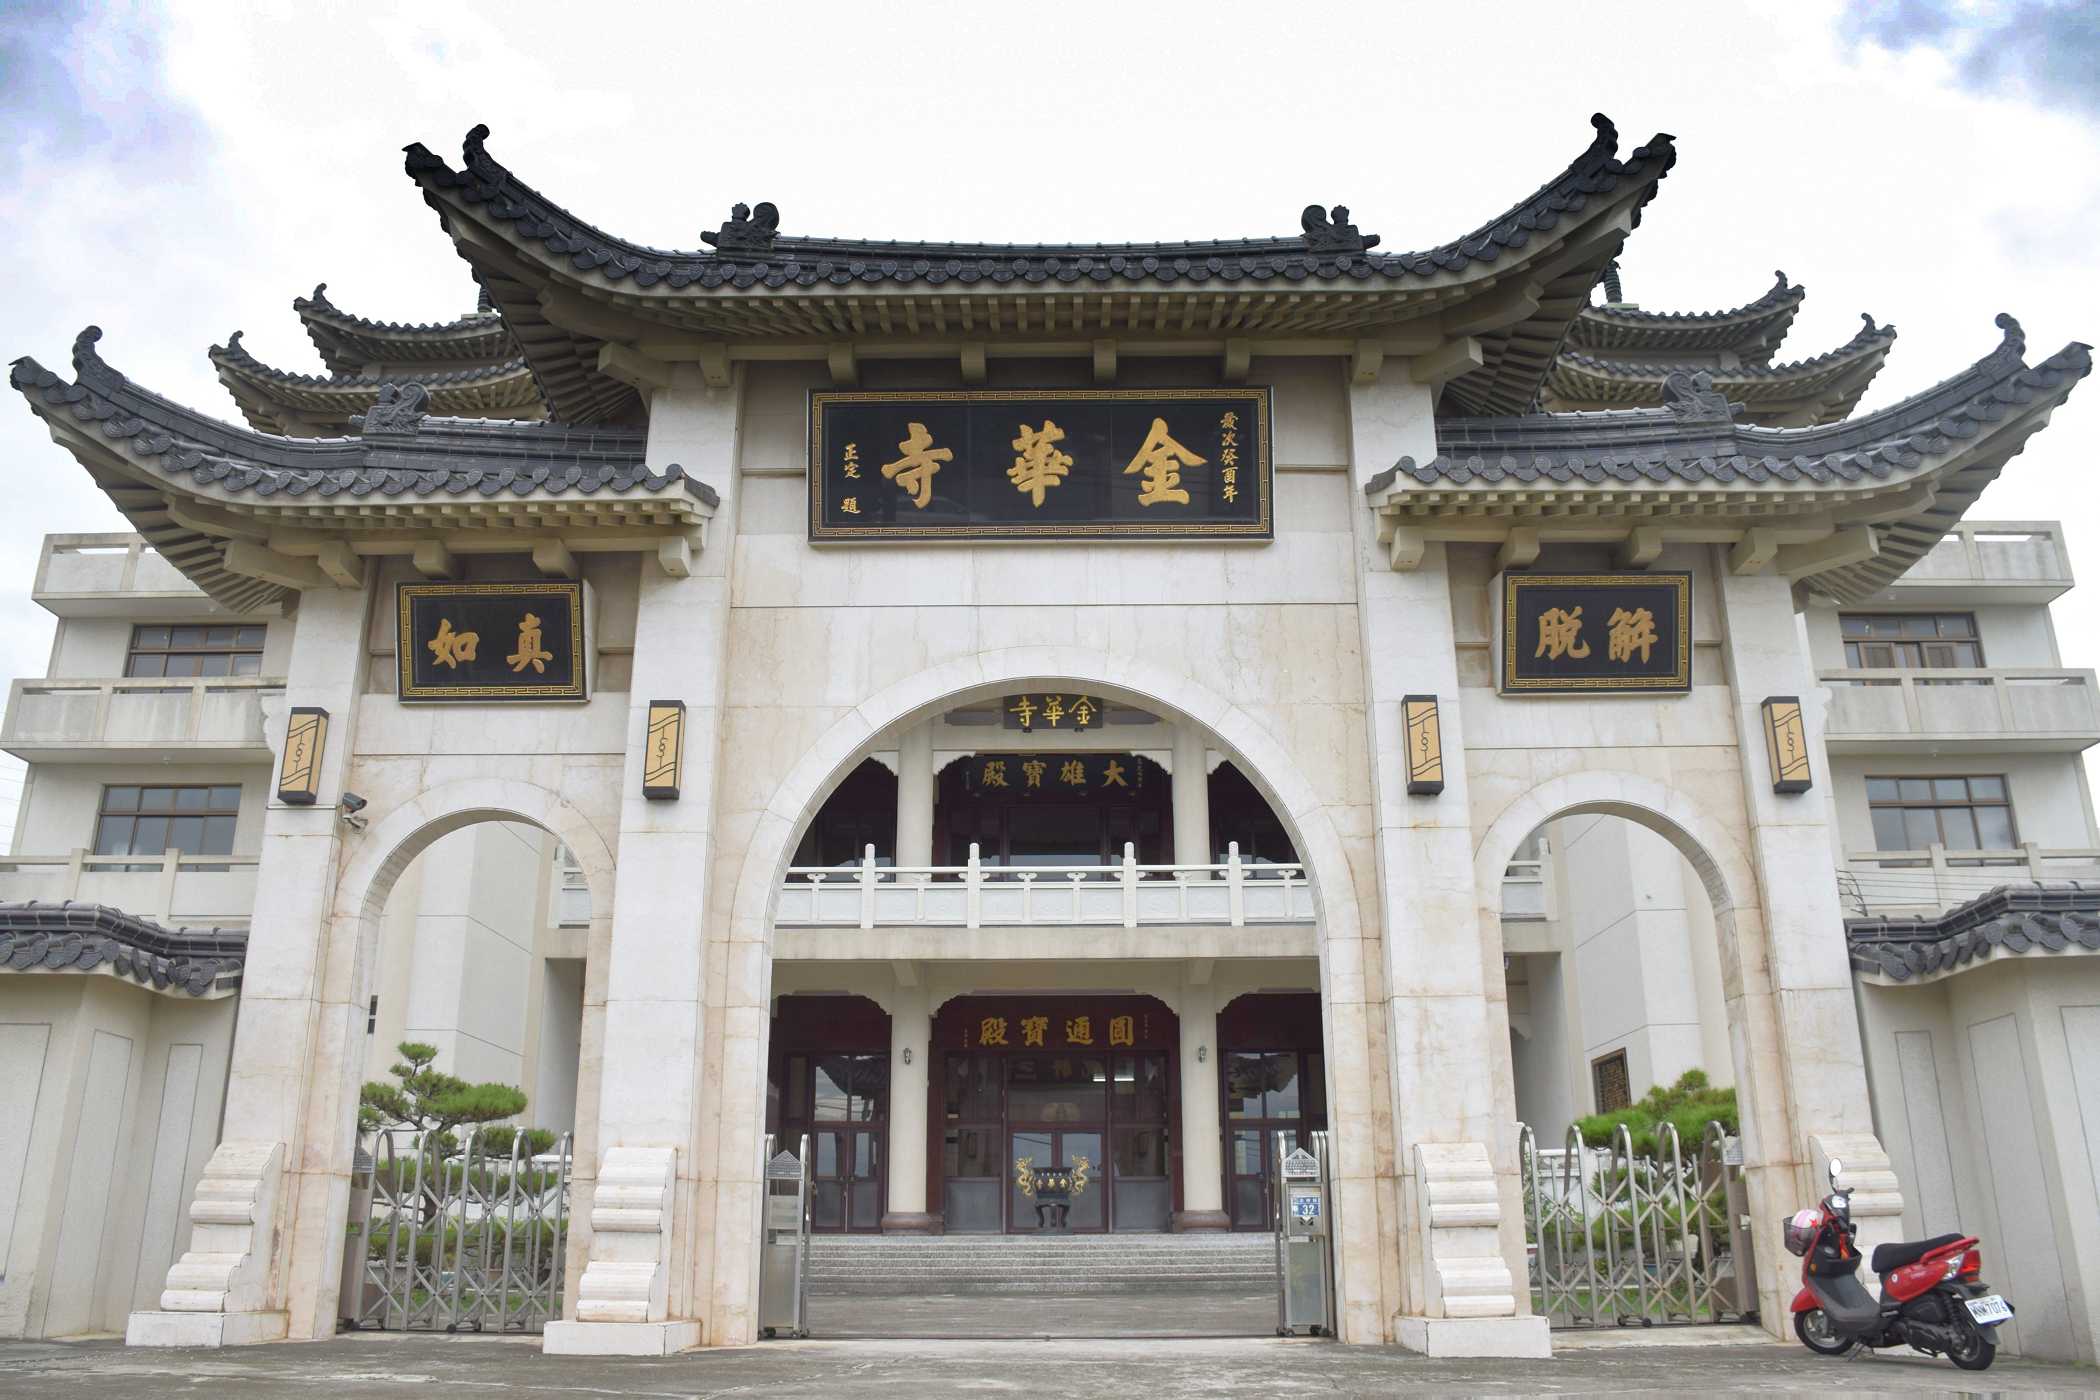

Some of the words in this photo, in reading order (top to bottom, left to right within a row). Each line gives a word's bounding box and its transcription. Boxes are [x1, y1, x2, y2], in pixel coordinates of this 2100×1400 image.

[880, 417, 1207, 509] 金華寺
[1008, 695, 1097, 728] 金華寺
[981, 759, 1128, 789] 大雄寶殿
[978, 1015, 1135, 1047] 圓通寶殿
[1302, 1204, 1315, 1215] 32
